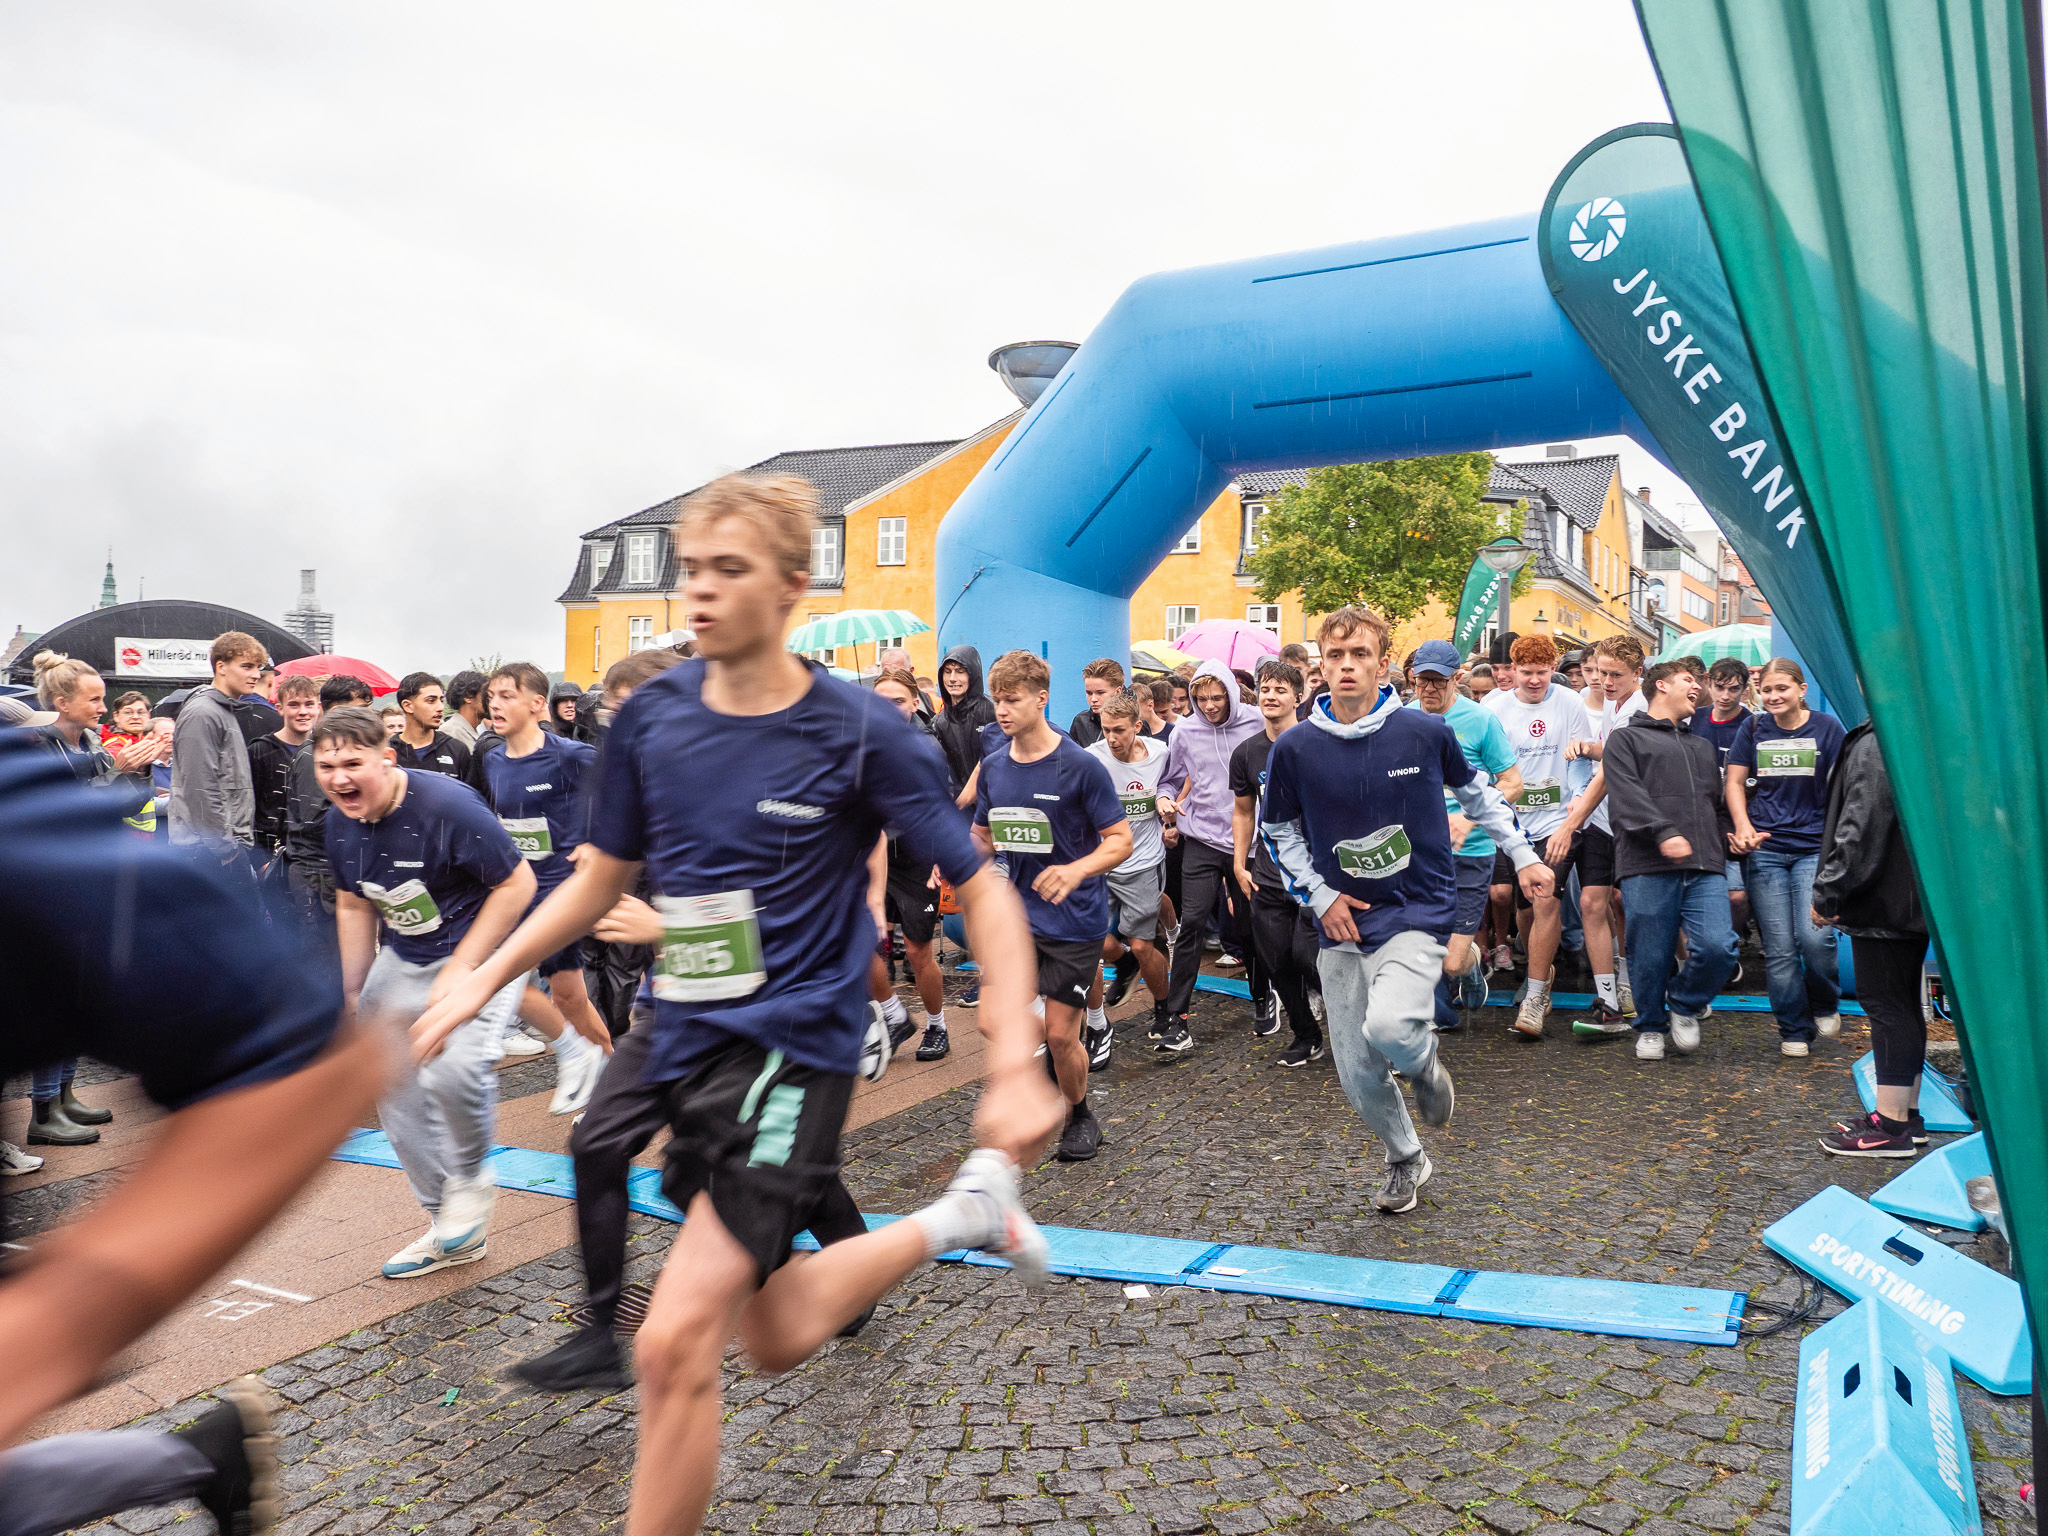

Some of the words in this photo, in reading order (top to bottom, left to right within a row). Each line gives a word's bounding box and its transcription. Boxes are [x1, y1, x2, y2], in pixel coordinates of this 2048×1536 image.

[1613, 268, 1722, 405] JYSKE
[1709, 402, 1806, 549] BANK
[1771, 754, 1799, 766] 581
[1387, 766, 1420, 777] U/NORD
[1527, 793, 1550, 805] 829
[1125, 802, 1147, 814] 826
[1003, 826, 1041, 842] 1219
[1352, 845, 1397, 869] 1311
[1808, 1232, 1966, 1335] SPORTSTIMING
